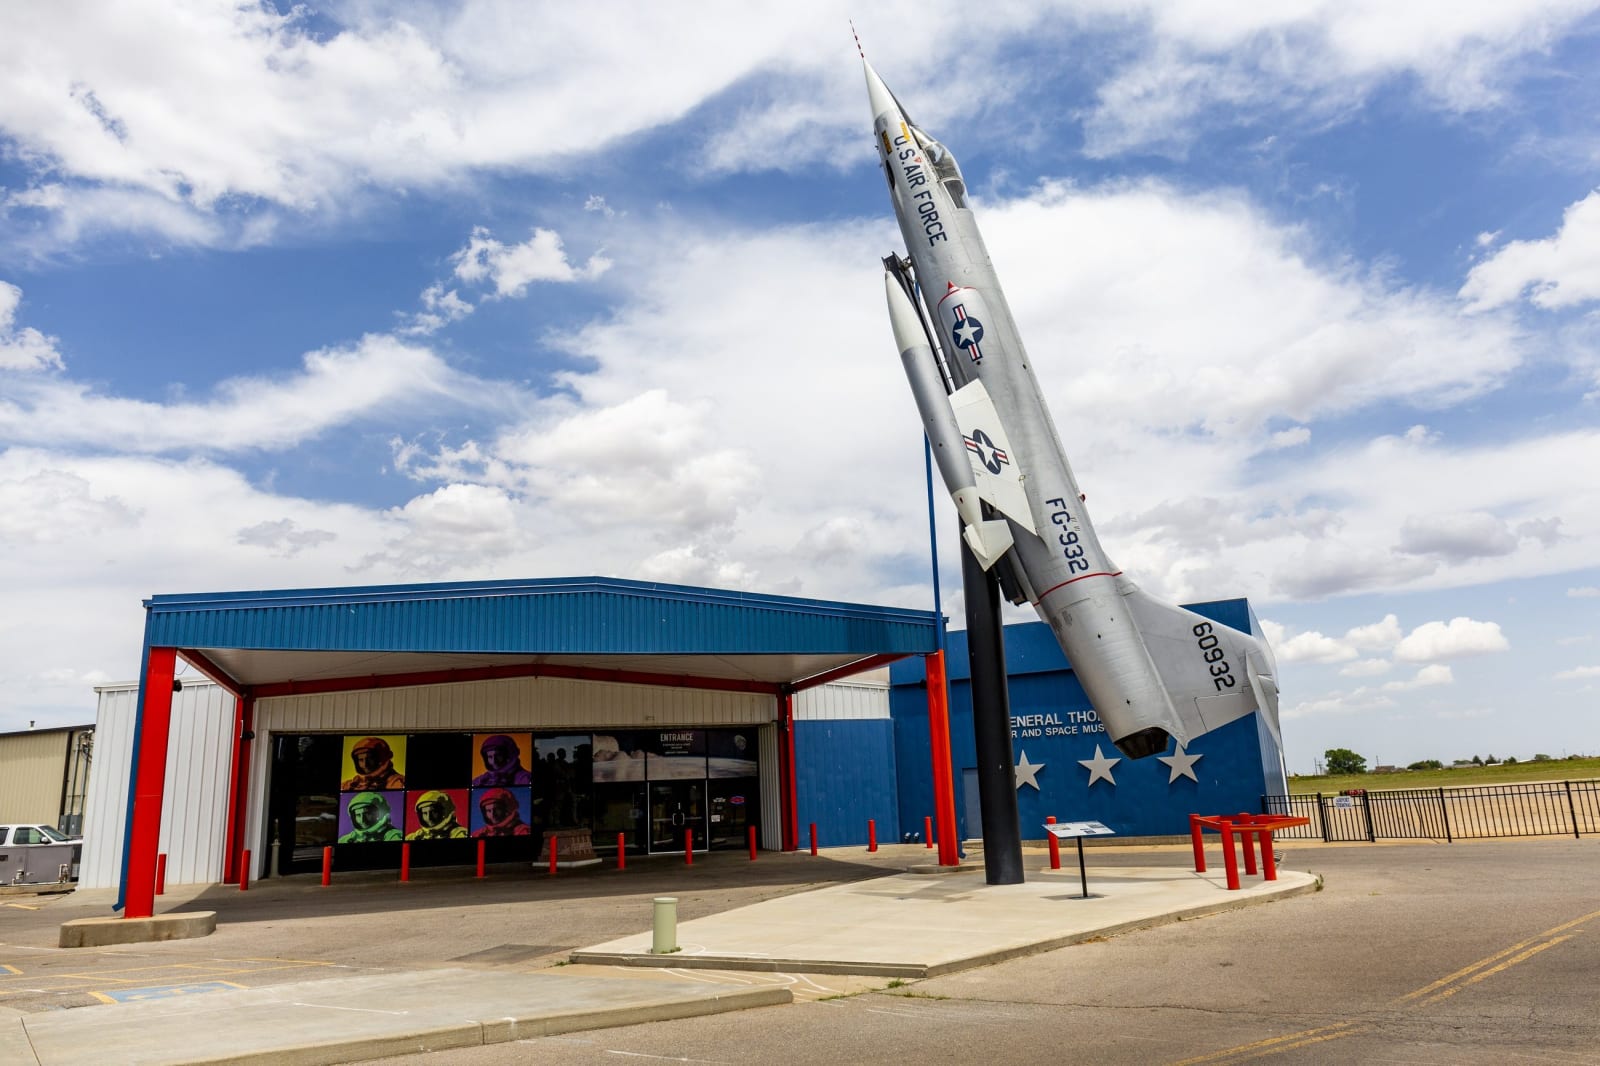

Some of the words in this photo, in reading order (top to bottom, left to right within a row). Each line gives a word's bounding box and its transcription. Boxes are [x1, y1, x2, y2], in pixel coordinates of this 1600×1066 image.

[904, 164, 926, 189] AIR
[914, 190, 948, 247] FORCE
[1045, 497, 1089, 574] FG-932
[1192, 621, 1236, 691] 60932
[1009, 713, 1063, 728] ENERAL
[1021, 728, 1042, 737] AND
[1045, 726, 1078, 736] SPACE
[1082, 723, 1105, 734] MUS
[660, 732, 694, 742] ENTRANCE
